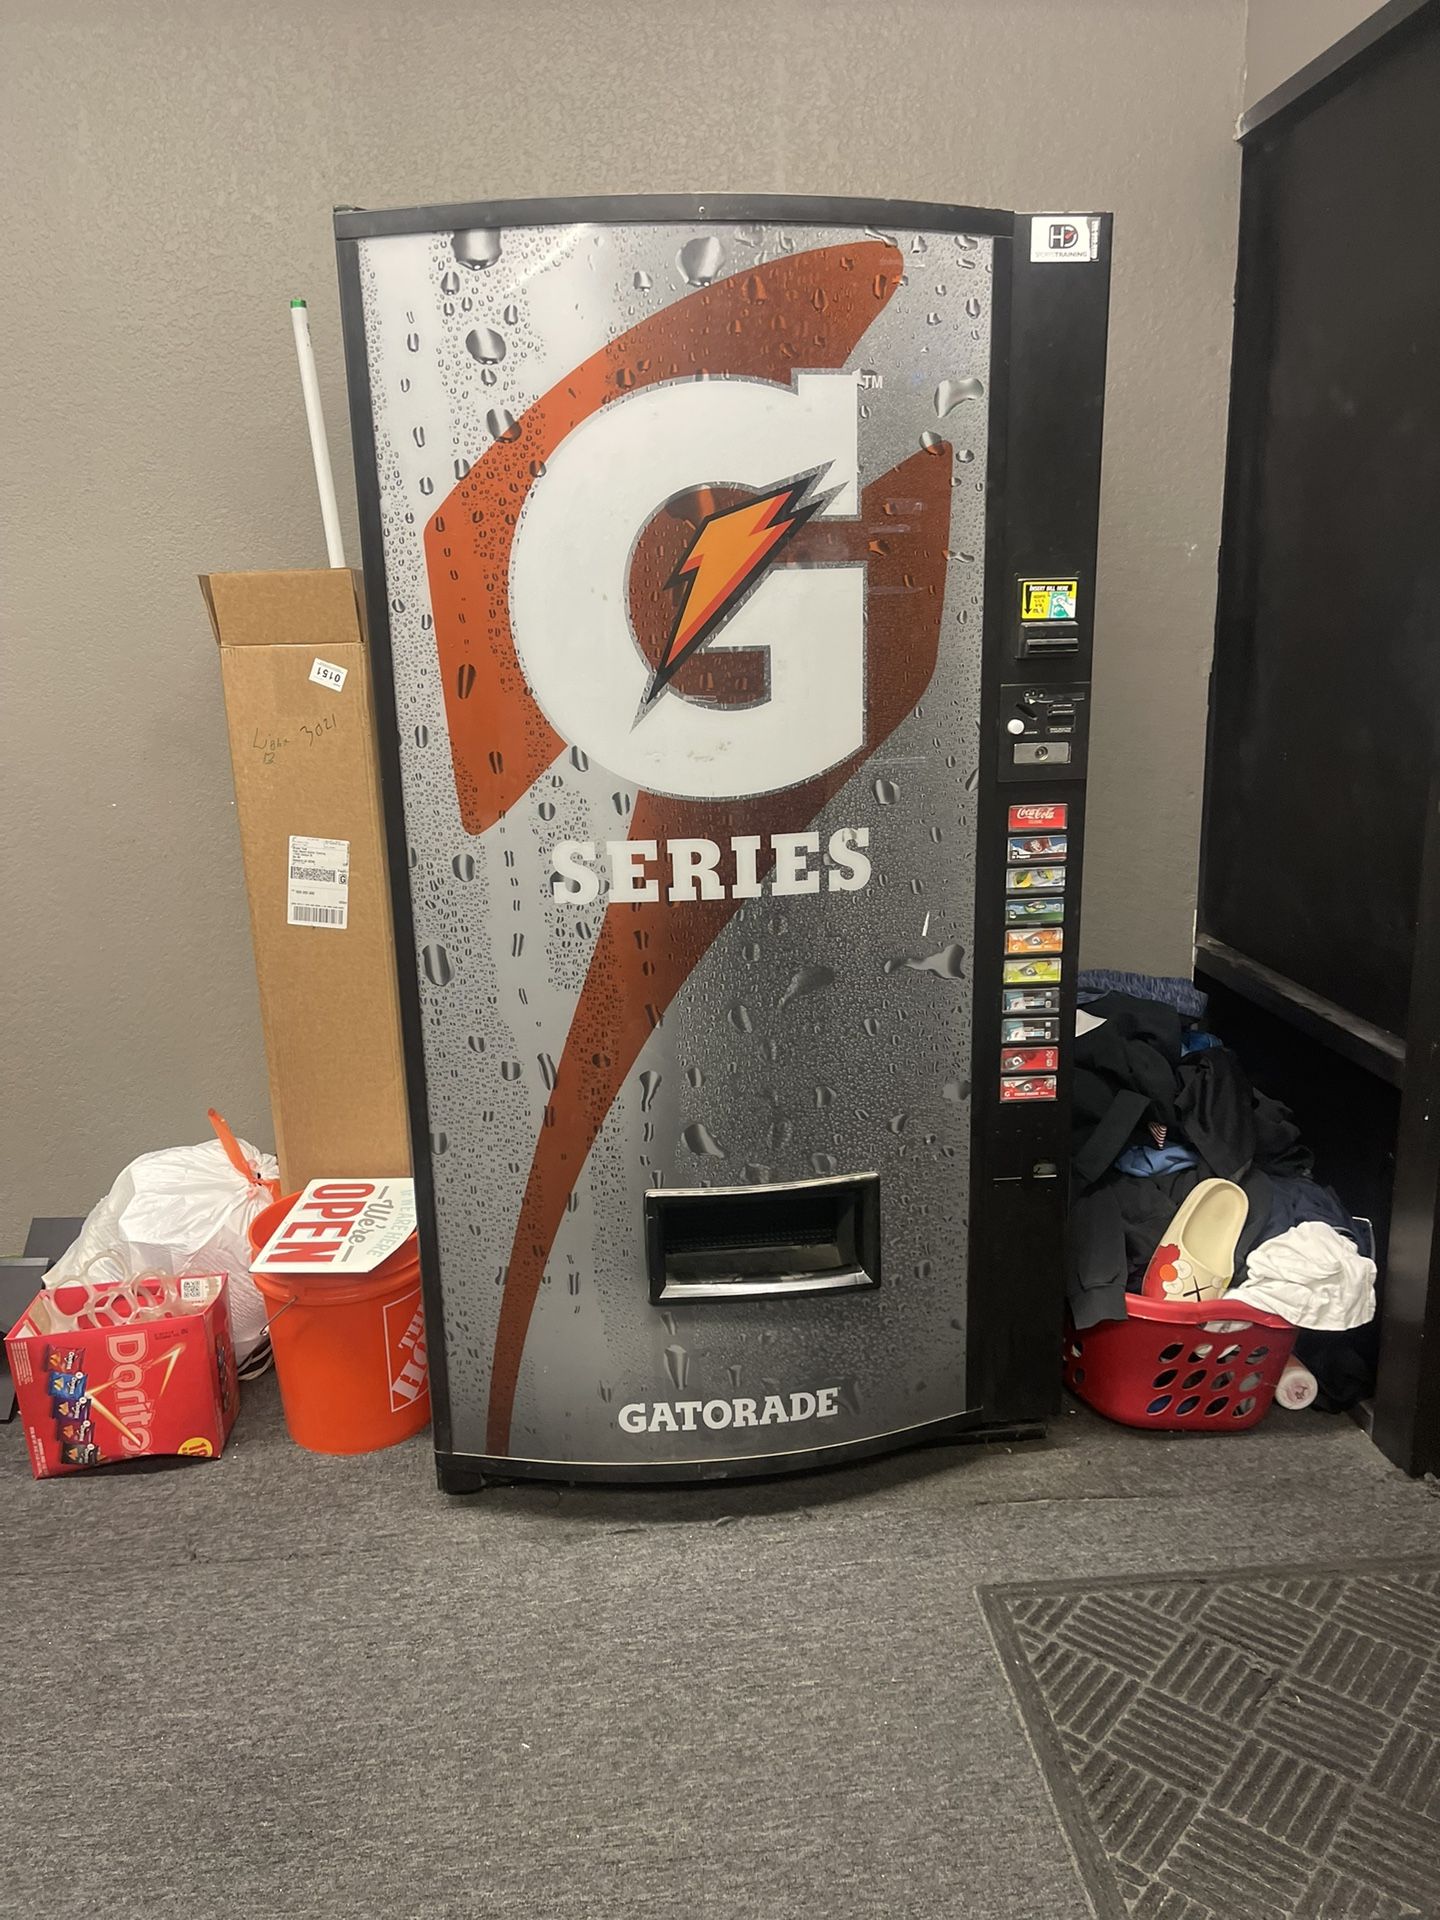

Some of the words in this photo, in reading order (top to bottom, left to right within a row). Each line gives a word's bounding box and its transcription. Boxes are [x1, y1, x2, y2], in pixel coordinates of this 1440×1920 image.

[508, 372, 868, 798] G
[862, 374, 883, 389] TM
[317, 666, 342, 683] 0151
[299, 713, 337, 748] 3021
[551, 827, 872, 905] SERIES
[266, 1183, 376, 1263] OPEN
[348, 1199, 395, 1245] We're
[366, 1231, 403, 1258] HERE
[106, 1331, 154, 1456] Dorito
[618, 1387, 839, 1434] GATORADE
